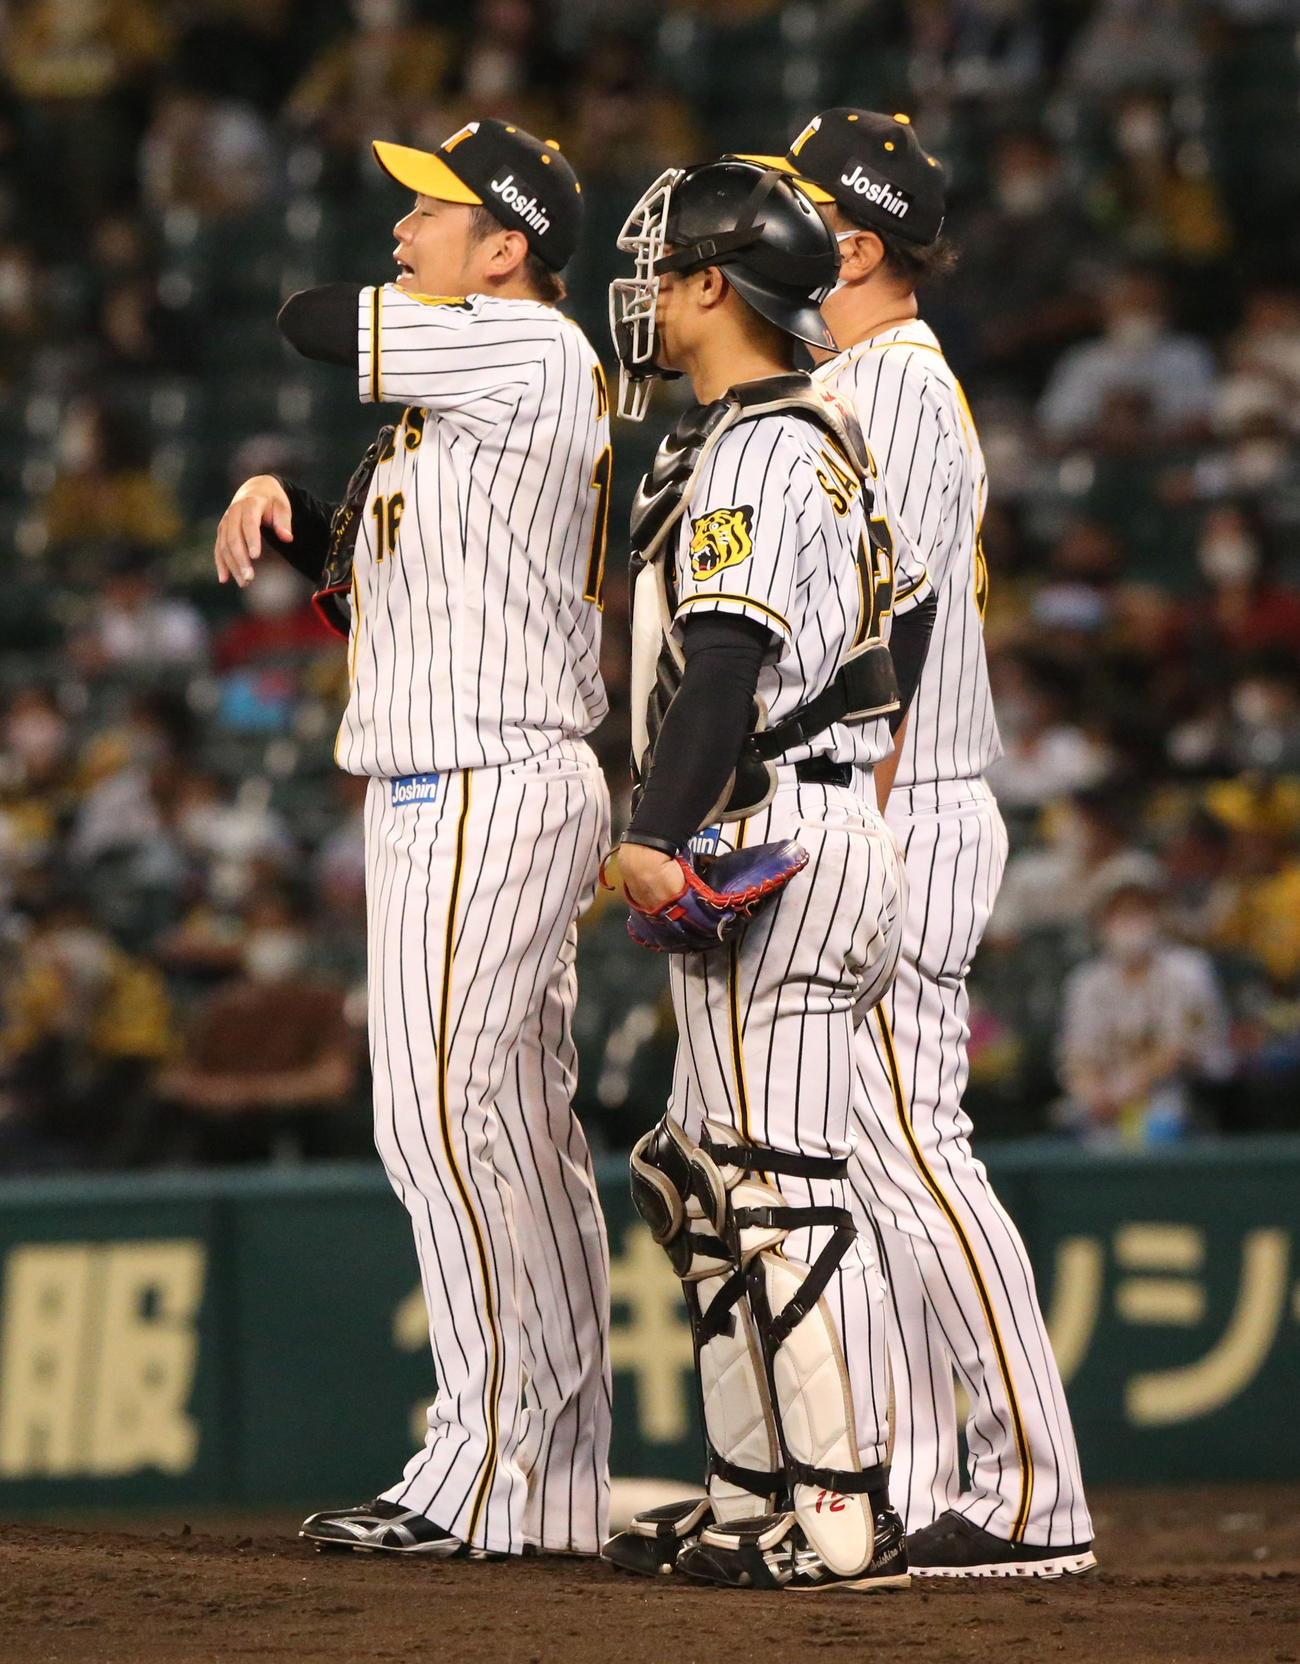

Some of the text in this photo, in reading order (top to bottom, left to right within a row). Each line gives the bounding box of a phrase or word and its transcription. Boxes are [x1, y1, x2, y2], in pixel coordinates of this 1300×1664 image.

[490, 174, 551, 236] Joshin
[840, 165, 910, 219] Joshin
[392, 777, 437, 804] Joshin
